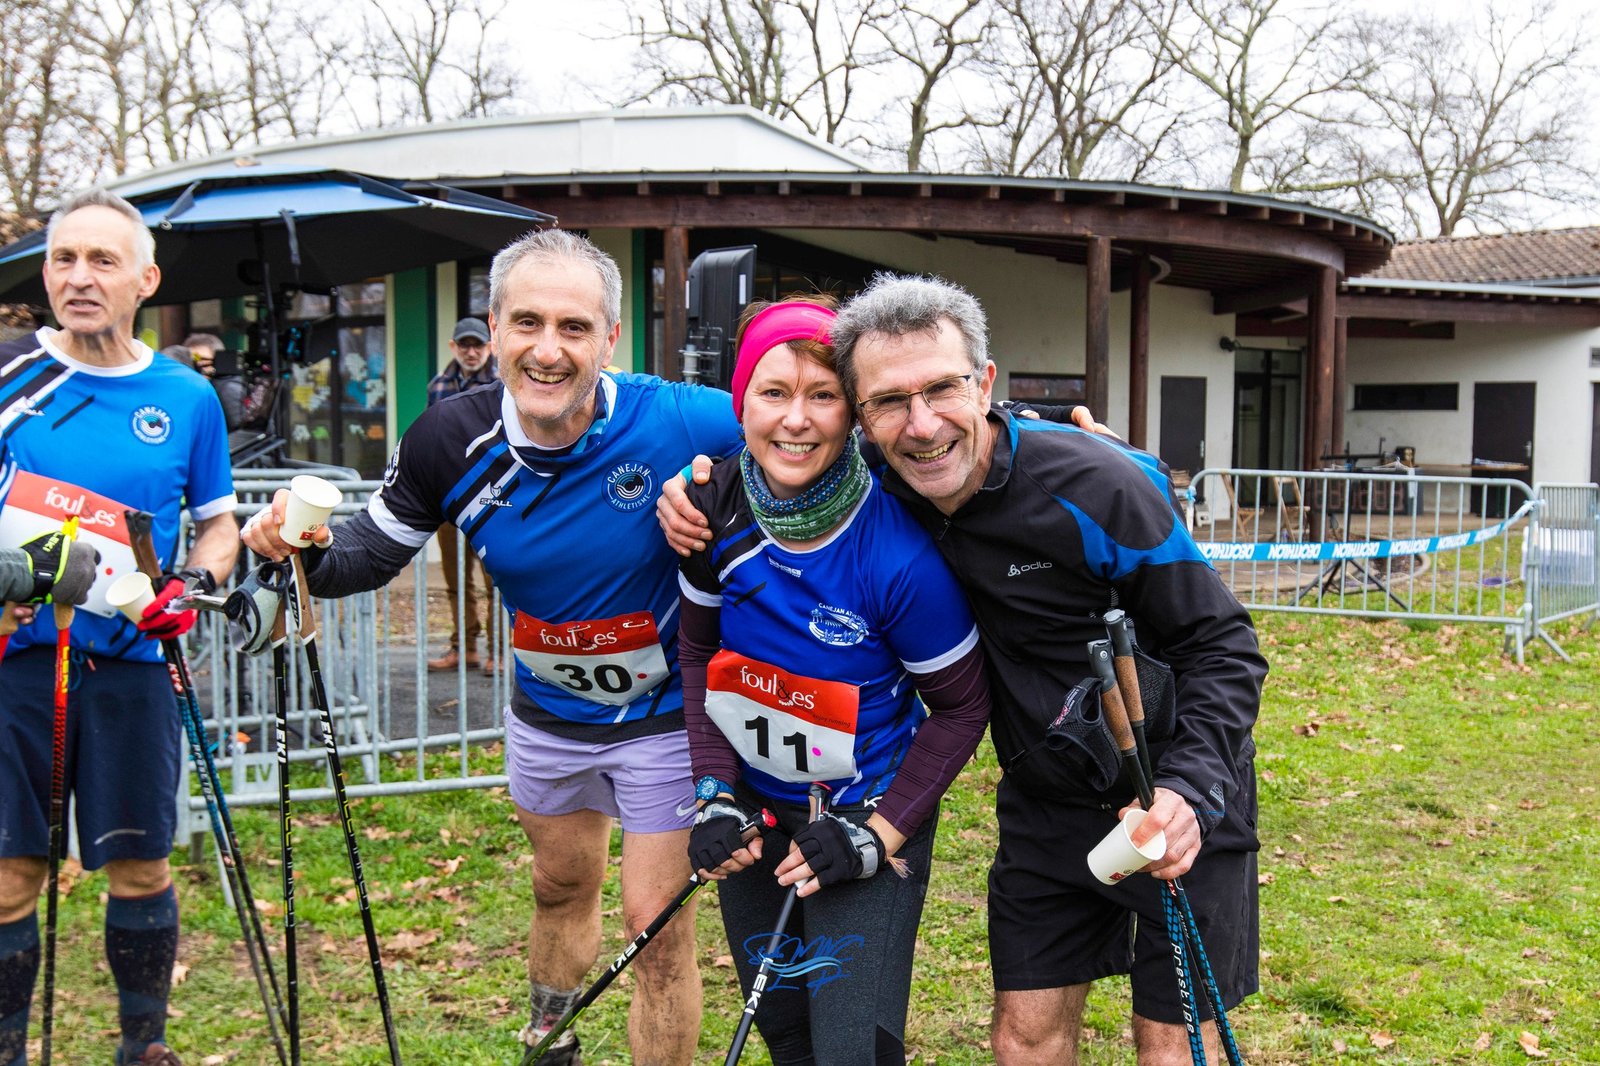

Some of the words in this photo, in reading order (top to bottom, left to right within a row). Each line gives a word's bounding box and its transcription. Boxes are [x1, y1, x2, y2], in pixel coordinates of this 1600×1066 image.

[607, 463, 651, 484] CANEJAN
[479, 497, 513, 507] SPALL
[610, 494, 651, 510] ATHLETISME
[1267, 543, 1322, 560] DECATHLON
[1331, 542, 1381, 559] DECATHLON
[1021, 561, 1053, 572] odlo
[553, 663, 633, 694] 30
[276, 716, 287, 763] LEKI
[744, 715, 810, 773] 11
[610, 930, 649, 973] LEKI
[744, 957, 774, 1015] LEKI
